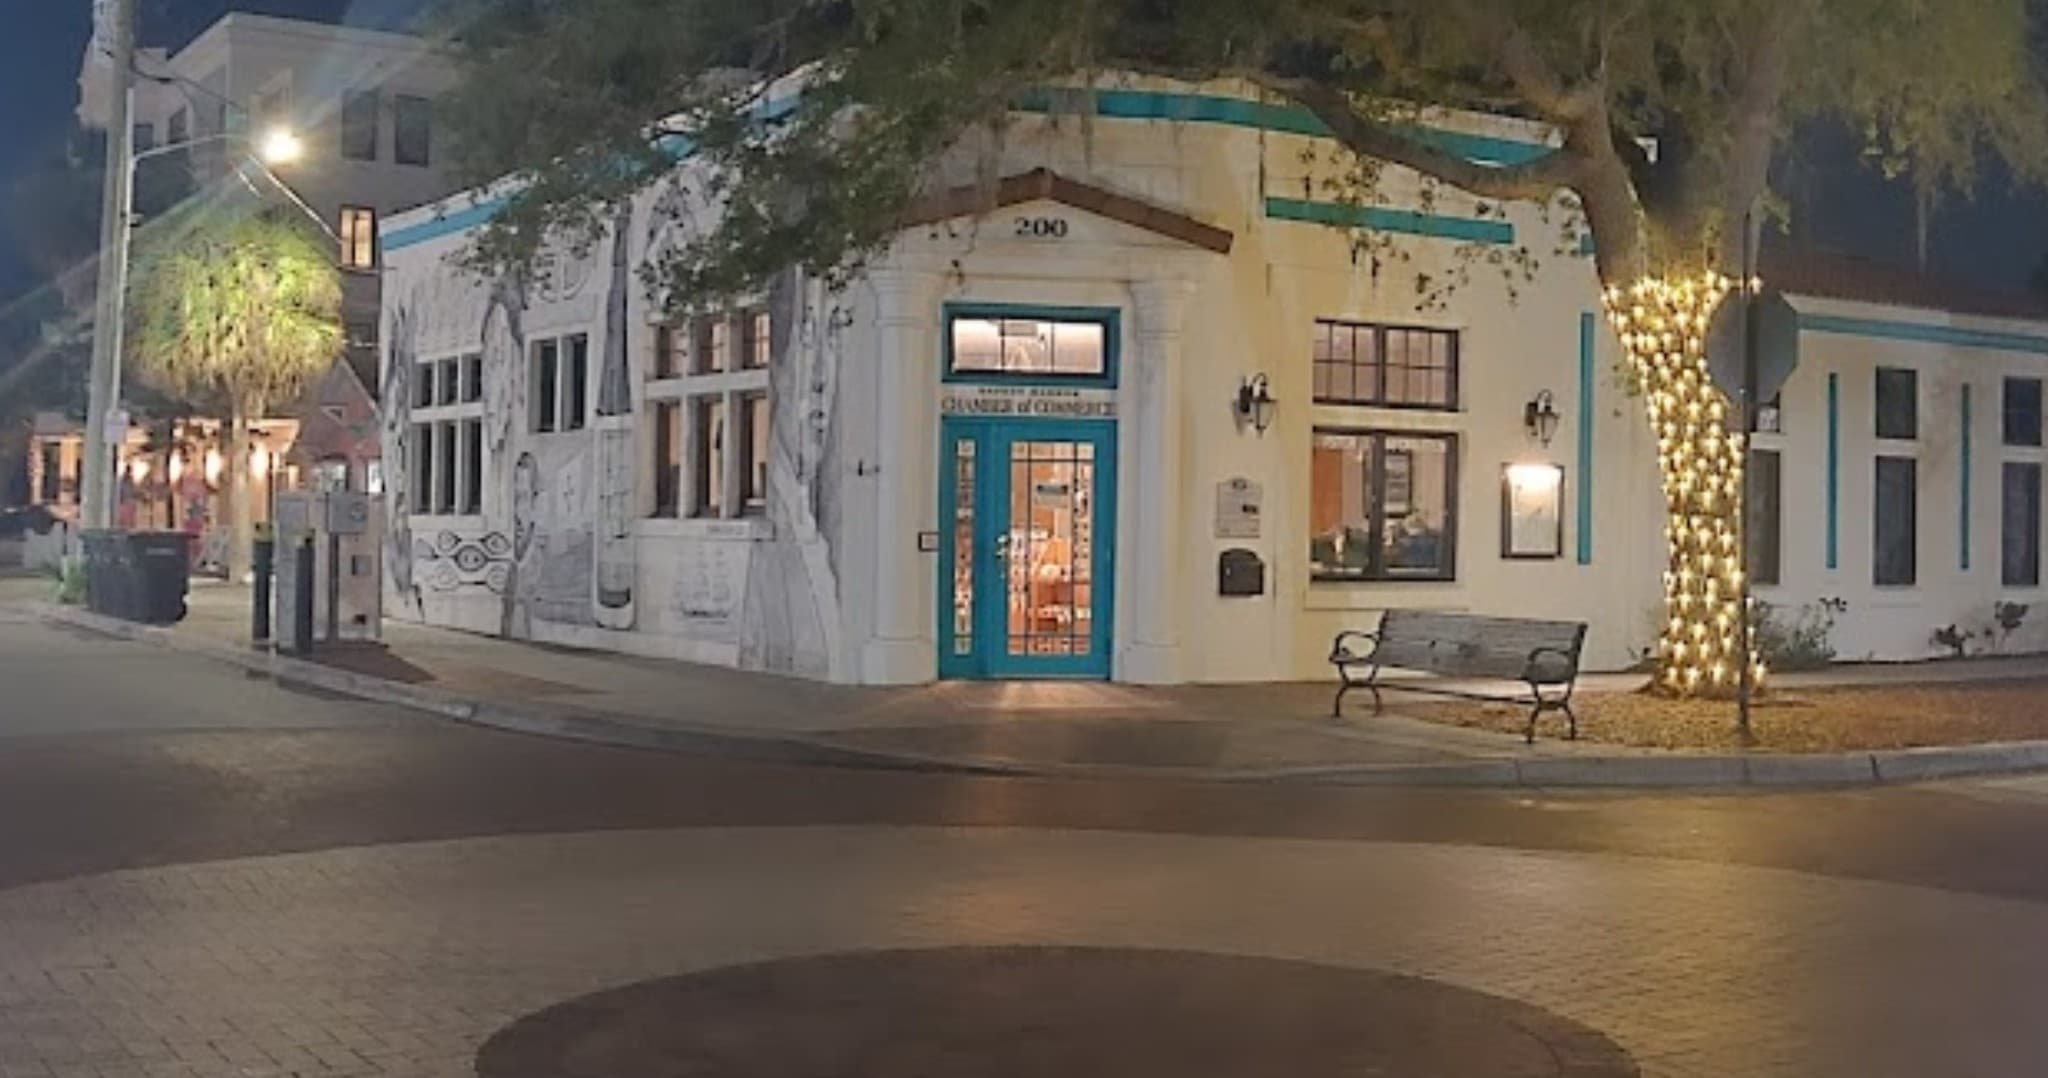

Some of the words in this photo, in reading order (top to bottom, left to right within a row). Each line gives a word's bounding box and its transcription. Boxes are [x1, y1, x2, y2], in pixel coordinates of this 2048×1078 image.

[1014, 217, 1068, 238] 200
[942, 396, 1012, 413] CHAMBER
[1017, 398, 1032, 413] of
[1034, 399, 1118, 416] COMMERCE
